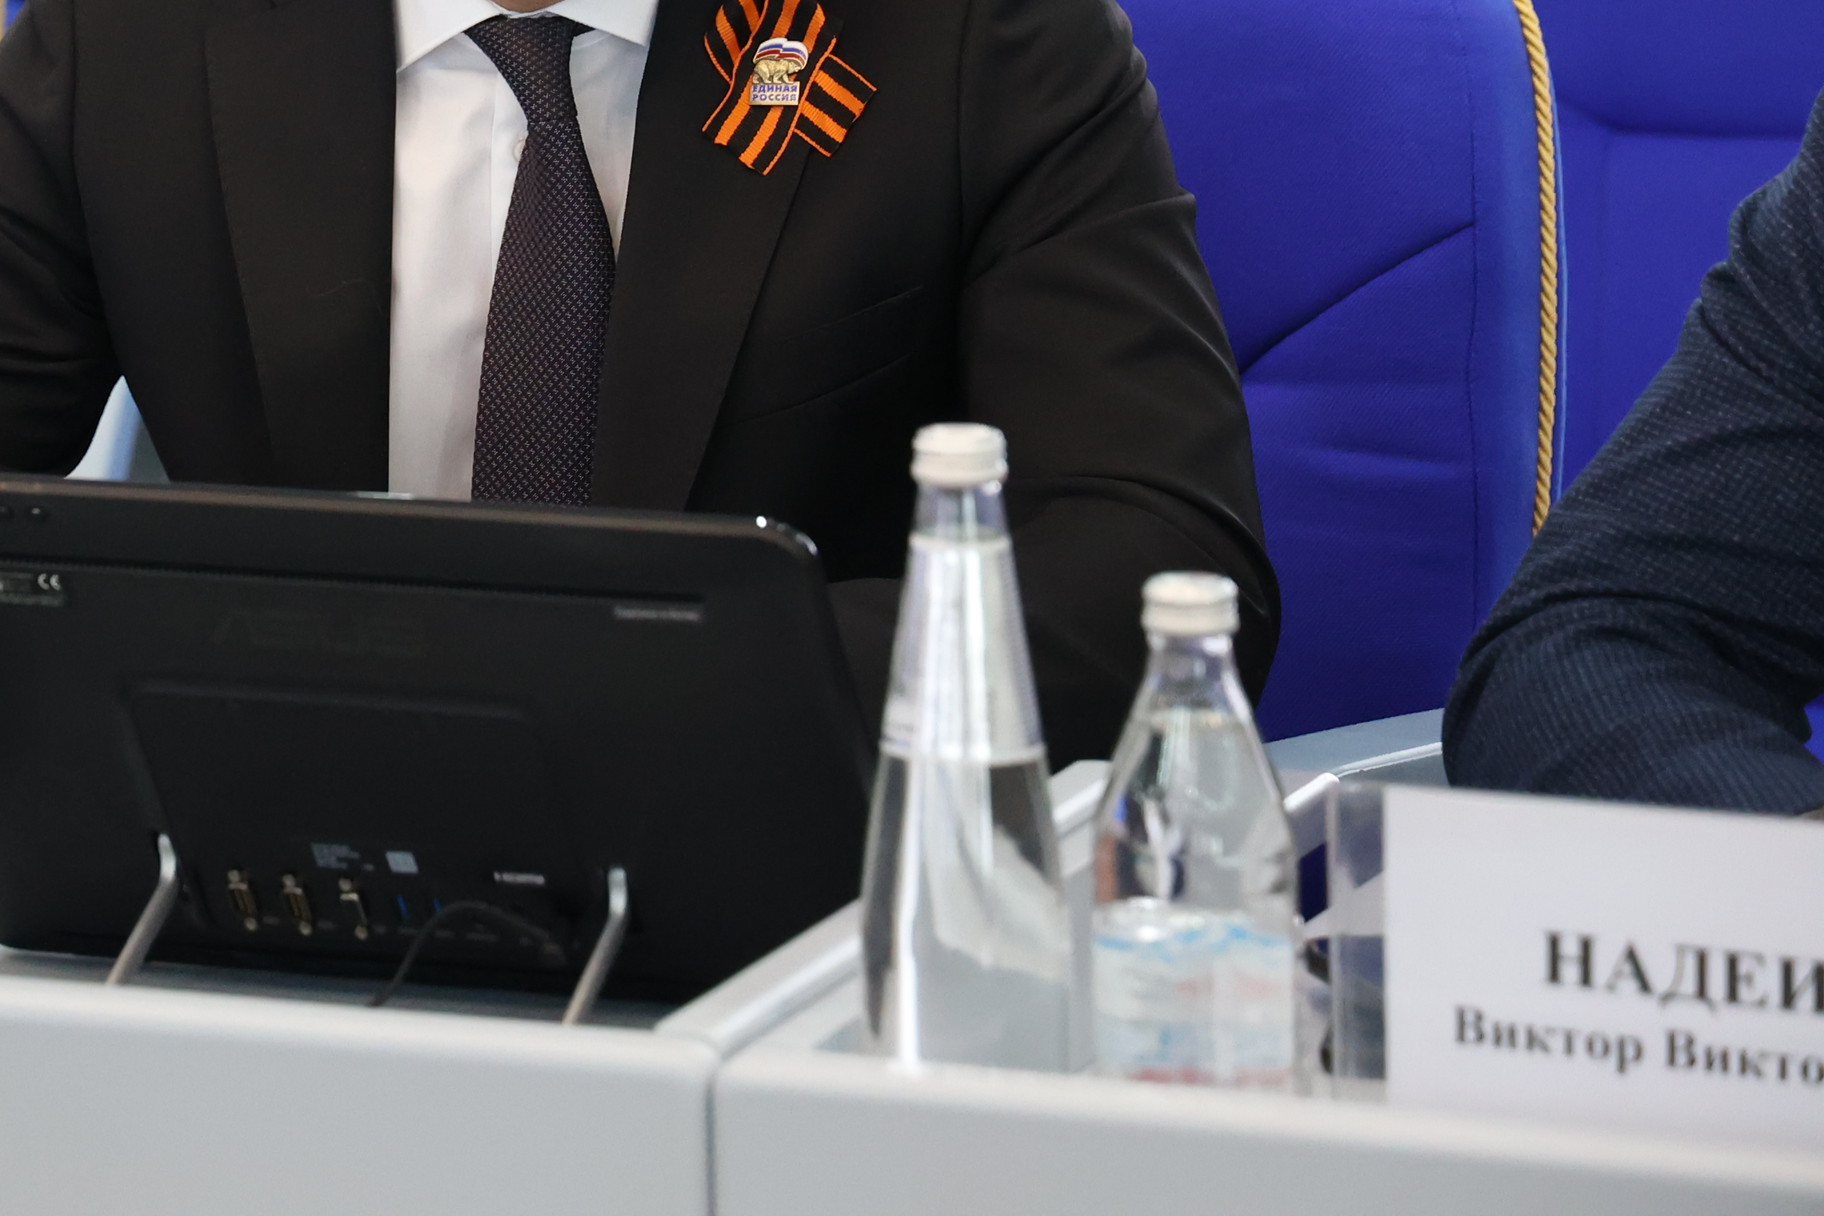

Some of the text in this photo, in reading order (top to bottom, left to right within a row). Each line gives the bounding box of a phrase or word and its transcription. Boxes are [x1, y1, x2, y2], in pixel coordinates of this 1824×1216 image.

[752, 84, 797, 93] ЕДИНАЯ
[752, 93, 796, 102] РОССИЯ
[1544, 930, 1824, 1015] НАДЕИ
[1454, 1004, 1824, 1086] Виктор Викто
